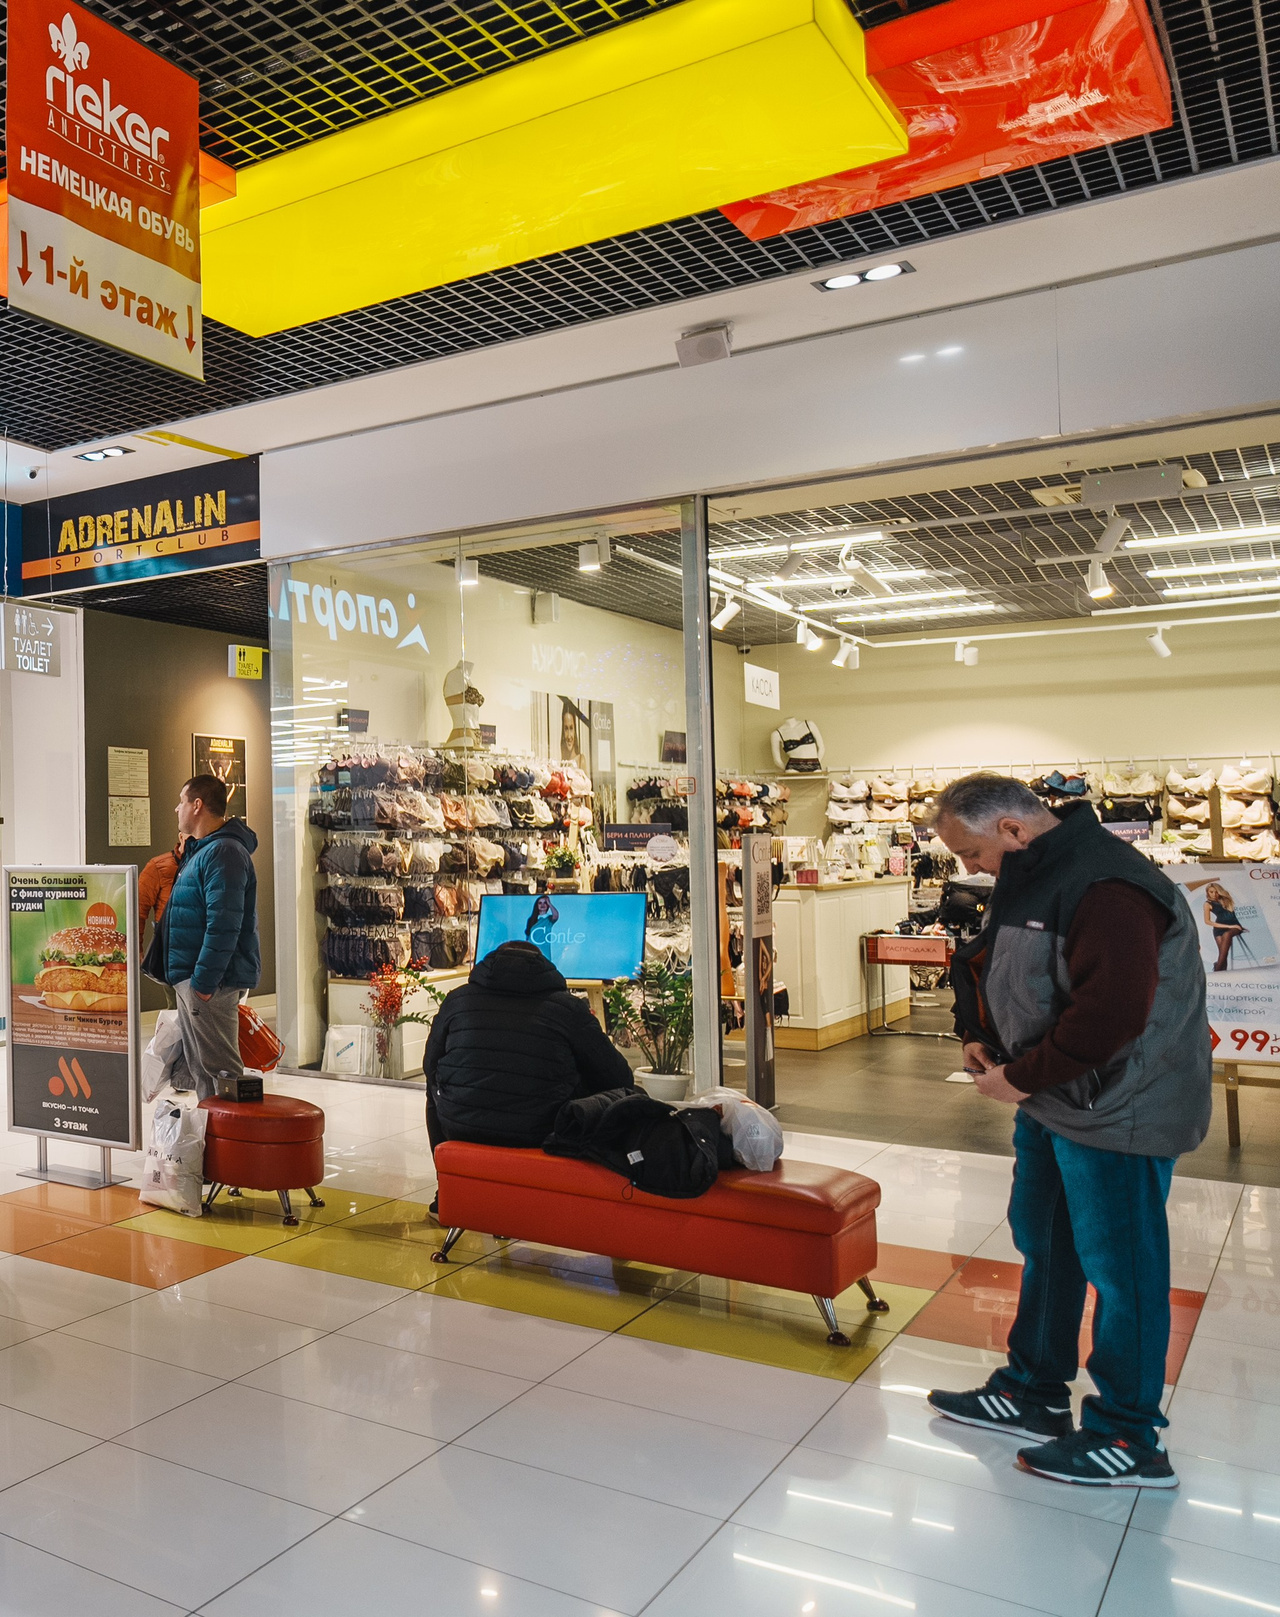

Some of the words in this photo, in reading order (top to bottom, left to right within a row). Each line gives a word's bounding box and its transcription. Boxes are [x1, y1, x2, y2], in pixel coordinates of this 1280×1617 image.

[45, 65, 170, 161] rieker
[48, 108, 167, 188] ANTISTRESS
[20, 145, 132, 223] НЕМЕЦКАЯ
[138, 206, 195, 253] ОБУВЬ
[39, 245, 89, 300] 1-й
[100, 280, 179, 339] этаж
[57, 490, 227, 554] ADRENALIN
[55, 529, 229, 571] SPORTCLUB
[12, 636, 53, 657] ТУАЛЕТ
[16, 654, 50, 673] TOILET
[238, 662, 254, 670] ТУАЛЕТ
[238, 668, 252, 676] TOILET
[751, 677, 774, 698] КАССА
[593, 712, 612, 731] Conte
[11, 876, 39, 885] Очень
[41, 875, 87, 885] большой.
[1249, 868, 1280, 880] Con
[11, 889, 18, 898] С
[19, 888, 44, 899] филе
[45, 888, 86, 899] куриной
[11, 901, 43, 911] грудки
[87, 916, 115, 925] НОВИНКА
[530, 926, 586, 945] Conte
[885, 945, 937, 953] РАСПРОДАЖА
[1218, 995, 1273, 1003] шортиков
[1218, 1006, 1266, 1015] лайкрой
[76, 1016, 97, 1024] Чикен
[99, 1017, 123, 1026] Бургер
[1230, 1028, 1270, 1053] 99
[42, 1101, 66, 1110] ВКУСНО
[78, 1106, 99, 1114] ТОЧКА
[54, 1117, 61, 1128] 3
[62, 1119, 88, 1131] этаж
[148, 1148, 183, 1165] ARINA
